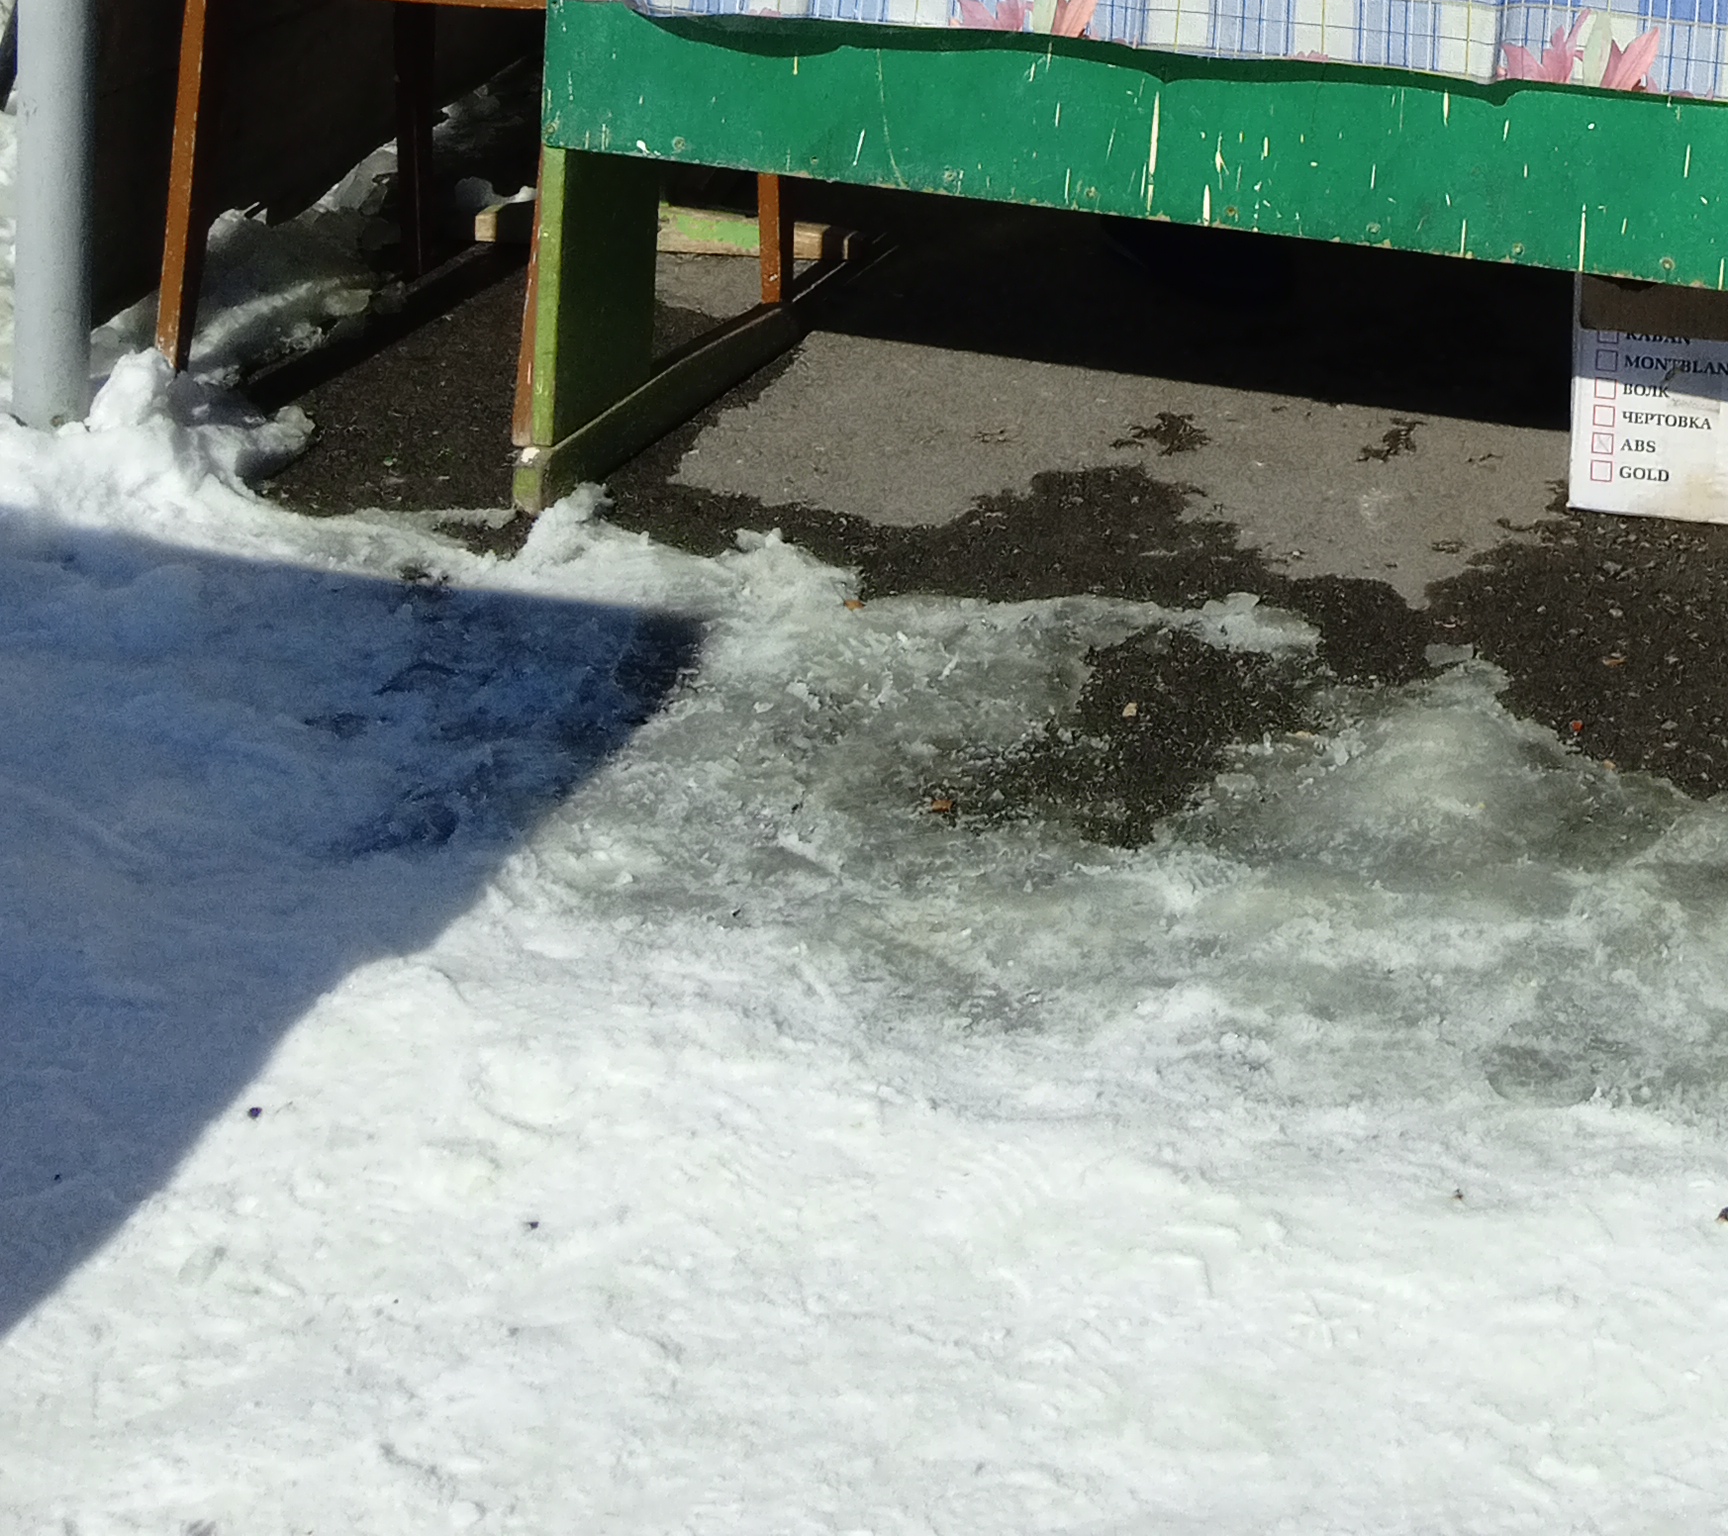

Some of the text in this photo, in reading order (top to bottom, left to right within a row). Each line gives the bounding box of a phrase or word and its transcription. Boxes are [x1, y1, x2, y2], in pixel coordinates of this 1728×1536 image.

[1622, 382, 1670, 399] ВОЛК
[1621, 410, 1713, 430] ЧЕРТОВКА
[1620, 438, 1657, 454] ABS
[1619, 465, 1671, 483] GOLD
